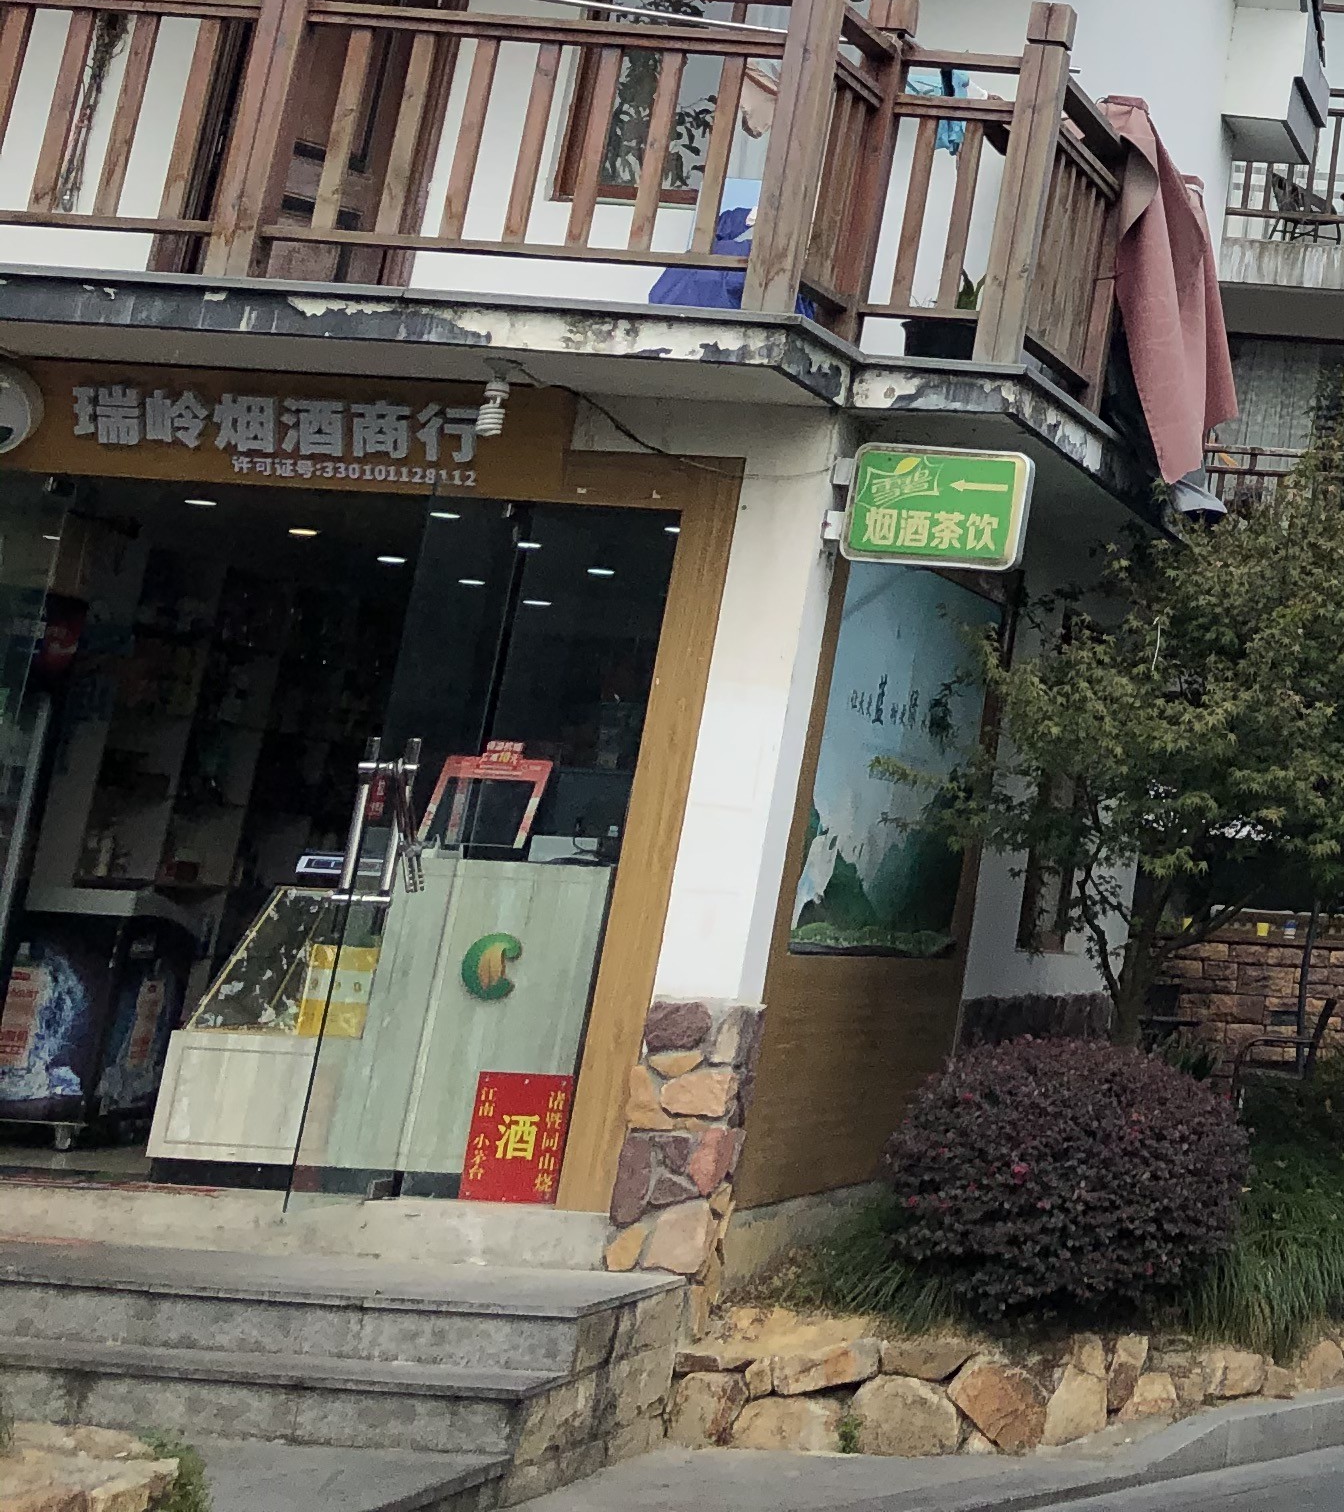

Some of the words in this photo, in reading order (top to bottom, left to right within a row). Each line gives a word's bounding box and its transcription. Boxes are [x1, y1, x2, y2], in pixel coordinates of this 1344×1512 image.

[73, 385, 479, 463] 瑞岭烟酒商行
[862, 506, 1000, 552] 烟酒茶饮
[494, 1114, 541, 1161] 酒
